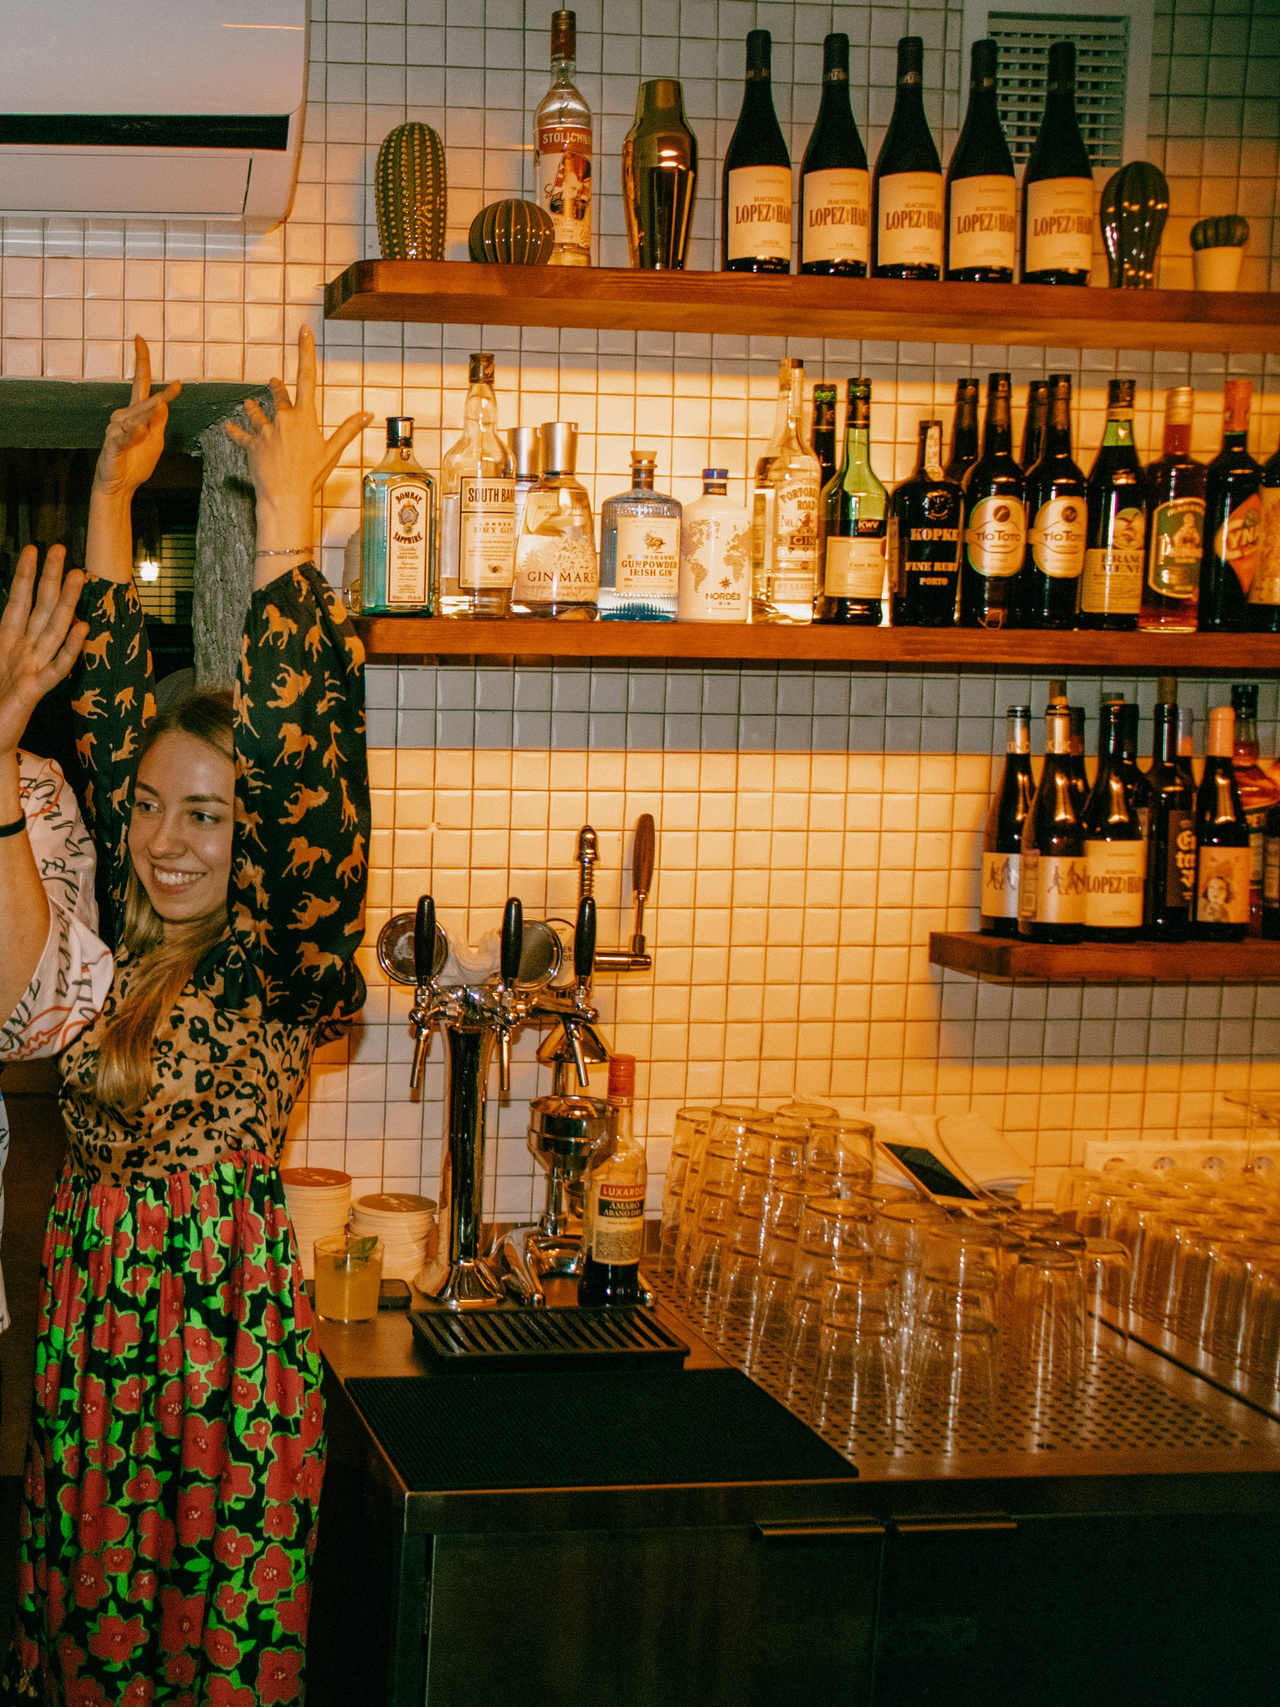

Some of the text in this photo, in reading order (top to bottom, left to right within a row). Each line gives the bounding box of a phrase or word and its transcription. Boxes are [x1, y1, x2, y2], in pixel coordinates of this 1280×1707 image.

[735, 203, 772, 224] LOPEZ
[808, 206, 846, 227] LOPEZ
[885, 209, 923, 231] LOPEZ
[956, 213, 995, 234] LOPEZ
[1033, 215, 1072, 236] LOPEZ
[394, 491, 423, 505] BOMBAY
[468, 487, 500, 503] SOUTH
[858, 520, 880, 529] KWV
[910, 527, 960, 541] KOPKE
[621, 560, 677, 569] GUNPOWDER
[905, 561, 932, 572] FINE
[527, 571, 595, 583] GIN MARE
[630, 568, 673, 577] IRISH GIN
[1086, 876, 1122, 894] LOPEZ
[609, 1200, 641, 1210] AMARO
